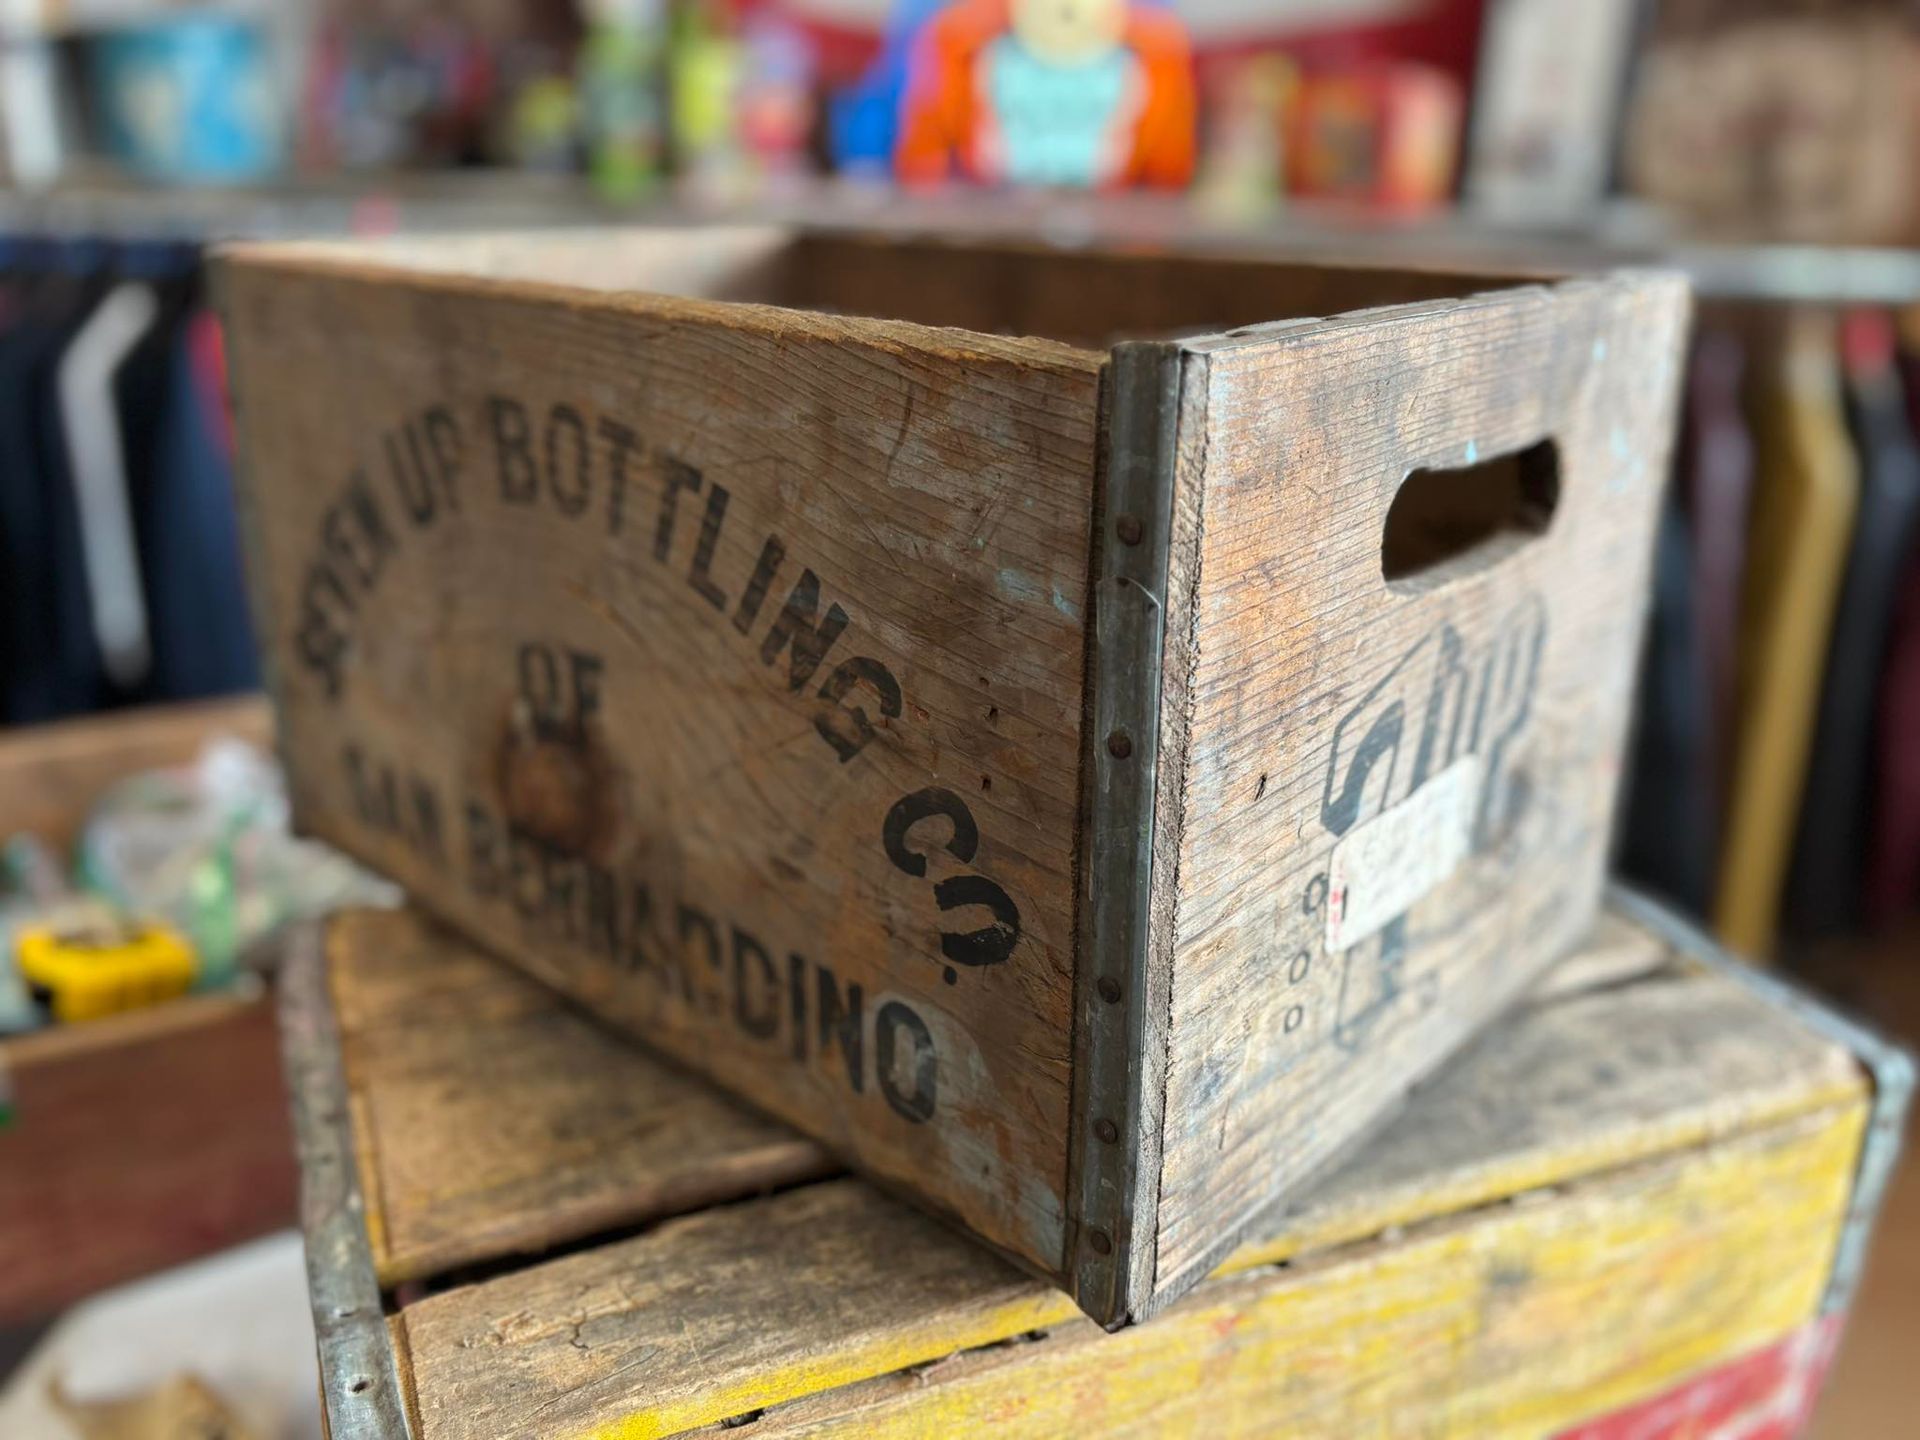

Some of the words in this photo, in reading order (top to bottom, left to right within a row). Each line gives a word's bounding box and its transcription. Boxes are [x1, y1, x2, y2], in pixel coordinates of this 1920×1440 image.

[382, 403, 466, 529] UP
[488, 395, 901, 763] BOTTLING
[517, 640, 606, 742] OF
